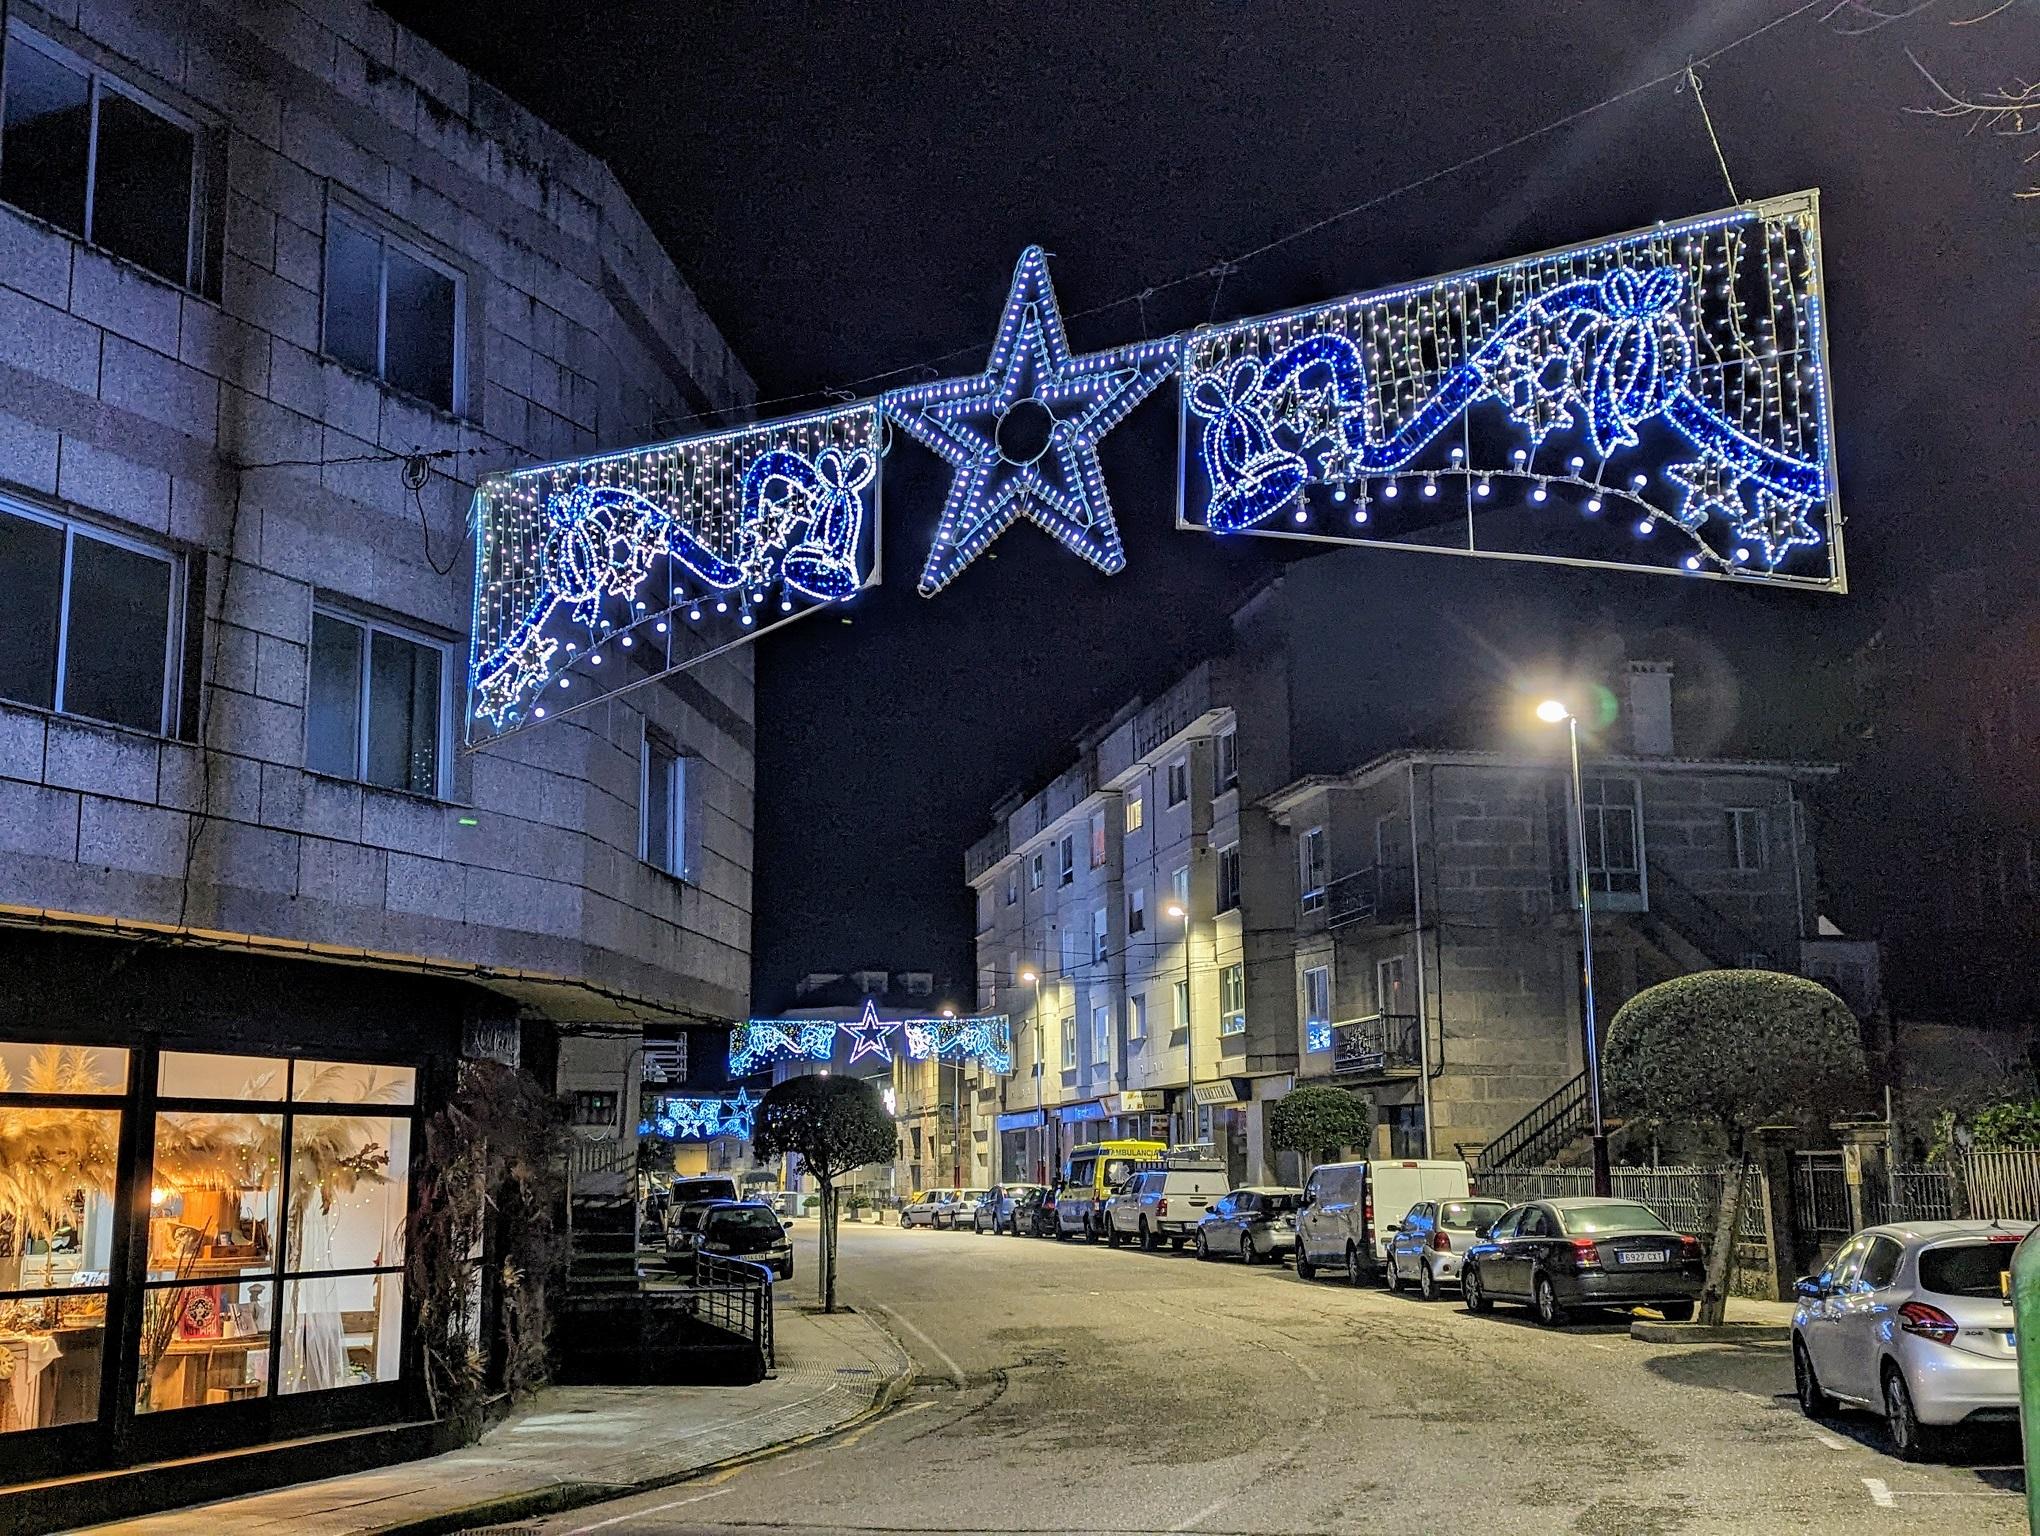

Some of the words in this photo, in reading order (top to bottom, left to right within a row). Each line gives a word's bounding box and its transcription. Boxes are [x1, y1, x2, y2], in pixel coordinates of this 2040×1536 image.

[1110, 1149, 1159, 1157] AMBULANCIA
[1625, 1253, 1645, 1262] 6927
[1647, 1252, 1662, 1260] CXT
